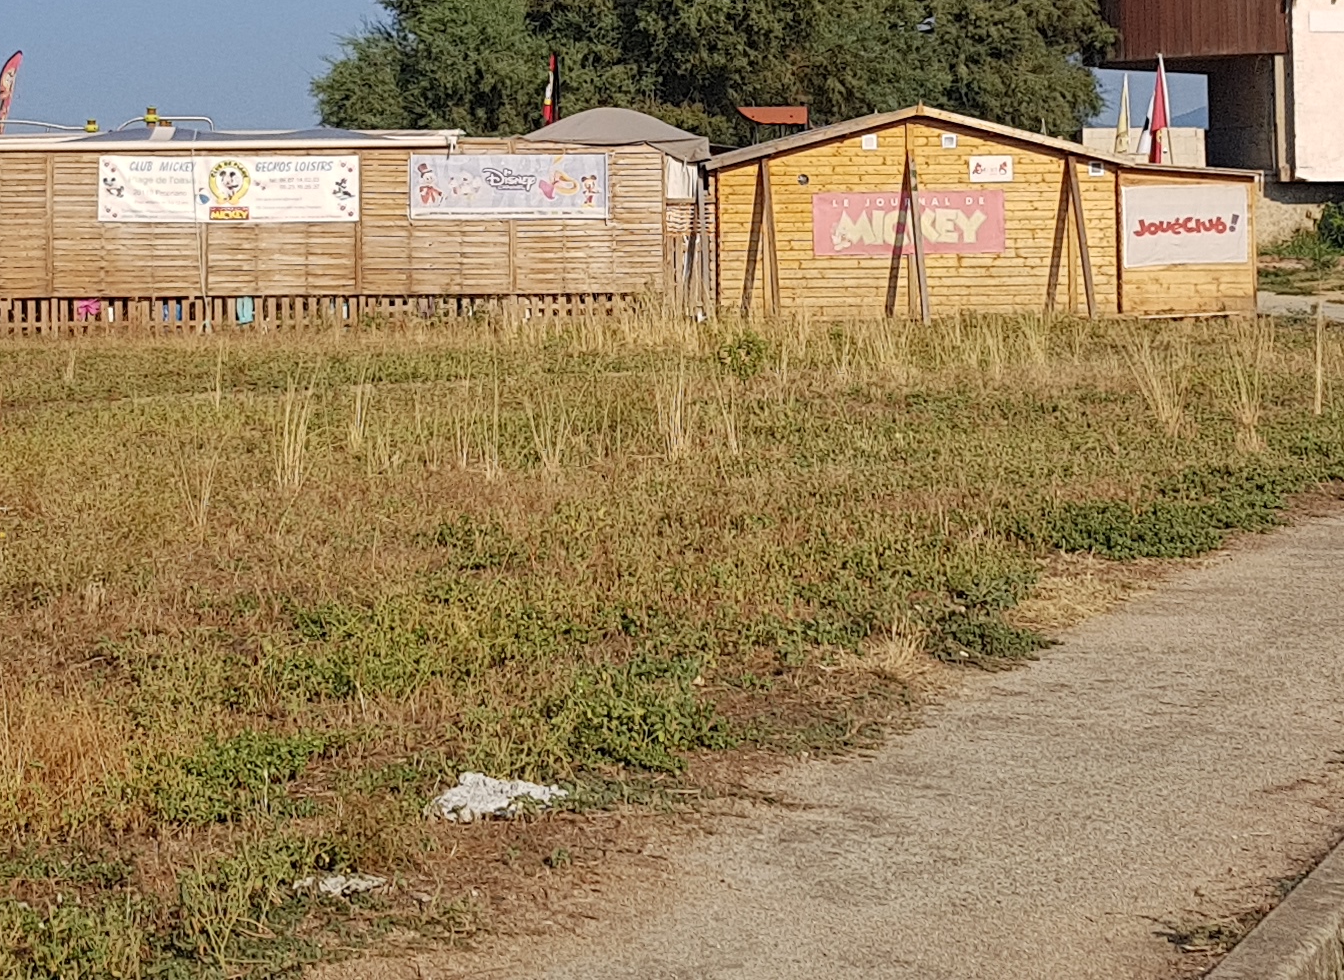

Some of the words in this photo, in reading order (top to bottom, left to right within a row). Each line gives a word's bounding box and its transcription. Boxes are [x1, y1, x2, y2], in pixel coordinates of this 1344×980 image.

[129, 161, 153, 172] CLUB
[159, 161, 196, 172] MICKEY
[295, 160, 333, 172] LOISIRS
[832, 199, 849, 208] LE
[865, 197, 951, 208] JOURNAL
[965, 197, 985, 206] DE
[834, 208, 988, 246] MICKEY
